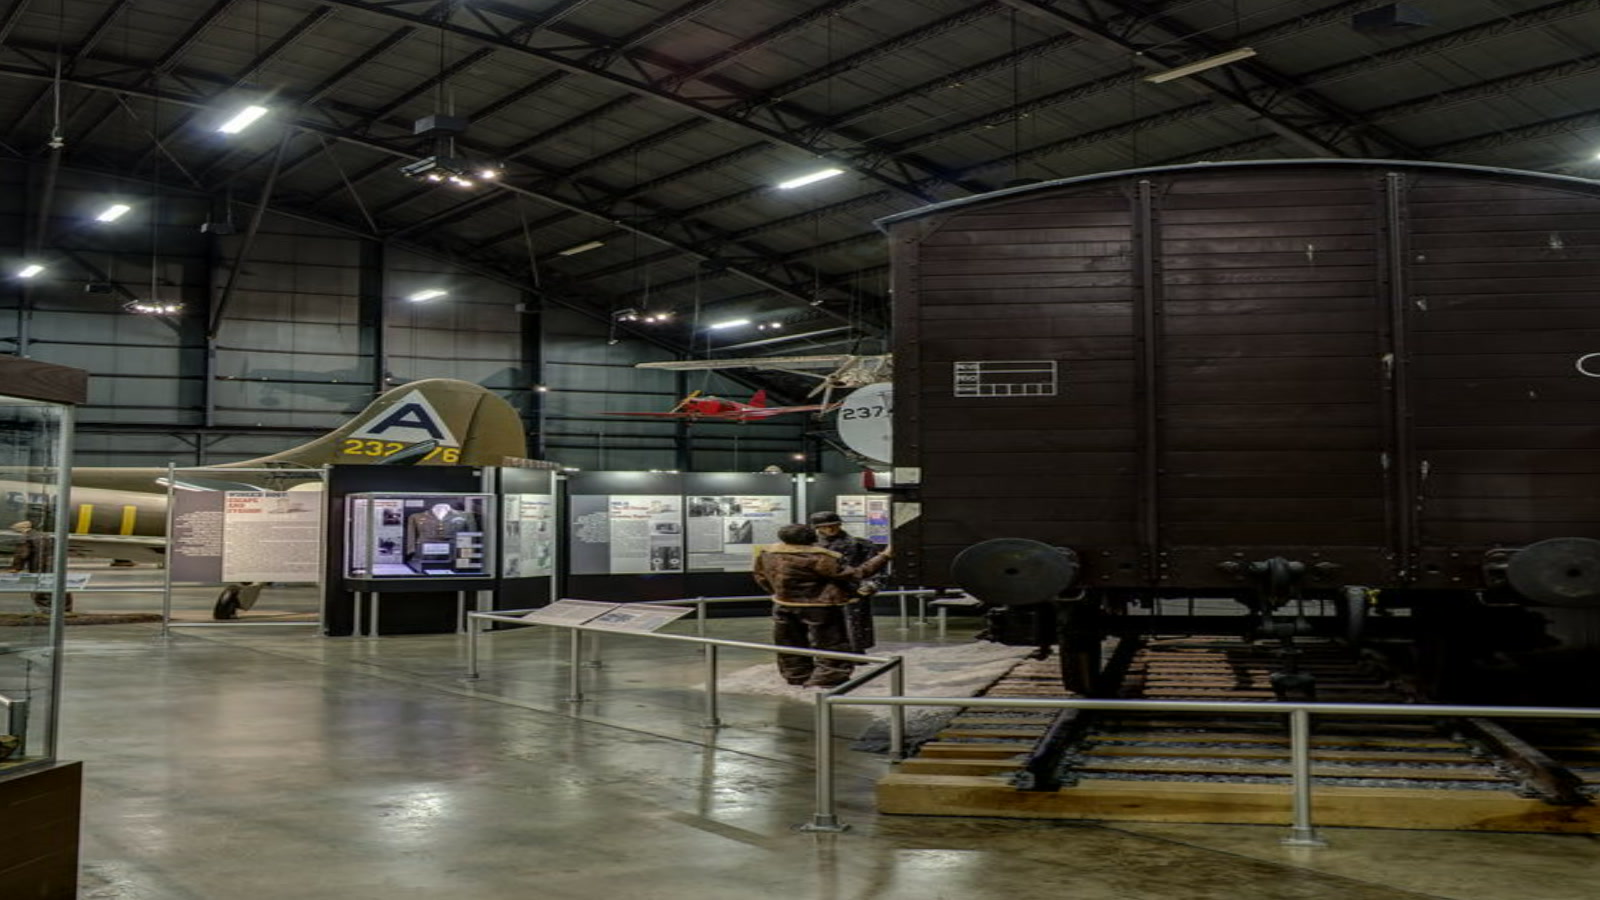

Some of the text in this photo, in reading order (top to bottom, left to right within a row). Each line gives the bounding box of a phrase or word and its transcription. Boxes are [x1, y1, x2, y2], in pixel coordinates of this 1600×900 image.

[367, 403, 445, 440] A
[842, 405, 893, 420] 237
[344, 439, 460, 463] 23276
